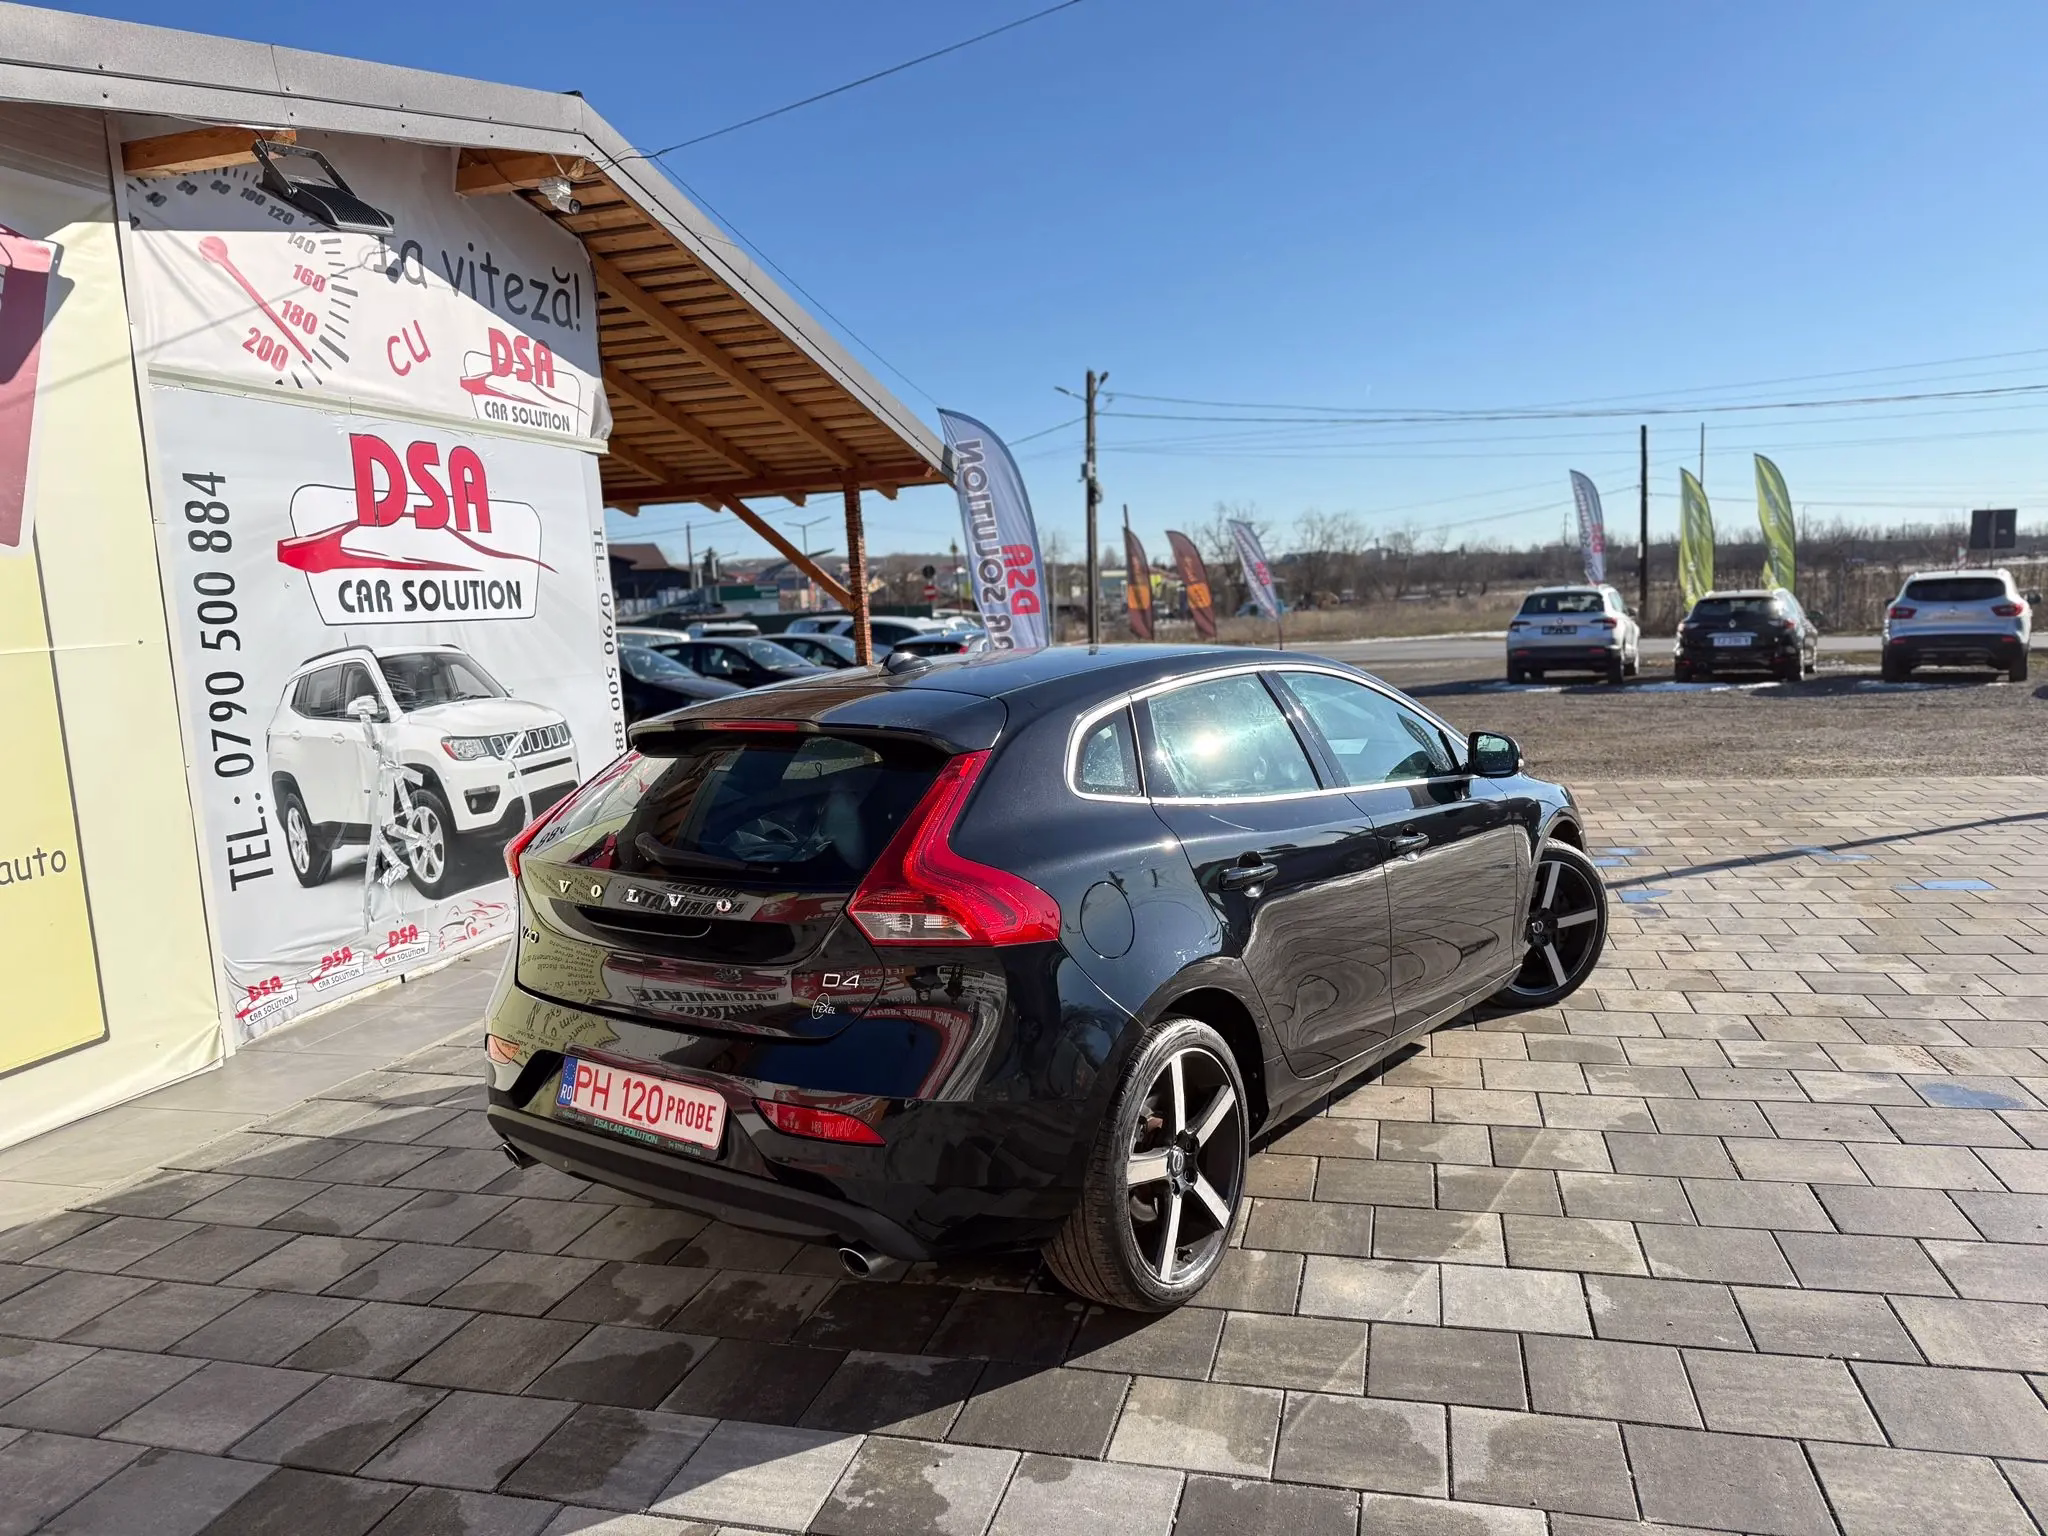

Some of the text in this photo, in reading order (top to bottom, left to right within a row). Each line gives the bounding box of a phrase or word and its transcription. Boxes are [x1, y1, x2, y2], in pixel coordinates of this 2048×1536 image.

[240, 187, 266, 206] 100
[267, 204, 295, 225] 120
[287, 230, 316, 255] 140
[292, 264, 327, 293] 160
[442, 242, 580, 332] viteză!
[281, 300, 317, 335] 180
[242, 326, 289, 372] 200
[388, 320, 432, 376] cu
[488, 327, 555, 388] DSA
[484, 401, 570, 432] CAR SOLUTION
[349, 433, 492, 533] DSA
[338, 579, 523, 612] CAR SOLUTION
[601, 592, 615, 655] 0790
[182, 471, 274, 891] TEL.: 0790 500 884
[605, 666, 622, 712] 500
[613, 721, 625, 756] 88
[0, 847, 66, 885] auto
[559, 879, 732, 912] VOLVO
[388, 924, 418, 948] DSA
[321, 946, 352, 972] DSA
[397, 946, 426, 961] SOLUTION
[246, 975, 283, 1002] DSA
[318, 968, 361, 989] CAR SOLUTION
[822, 973, 860, 989] D4
[249, 994, 294, 1022] CAR SOLUTION
[814, 1001, 836, 1015] TEXEL
[559, 1084, 573, 1101] RO
[574, 1065, 717, 1133] PH 120 PROBE
[593, 1117, 608, 1130] DSA
[608, 1122, 624, 1135] CAR
[623, 1126, 659, 1145] SOLUTION
